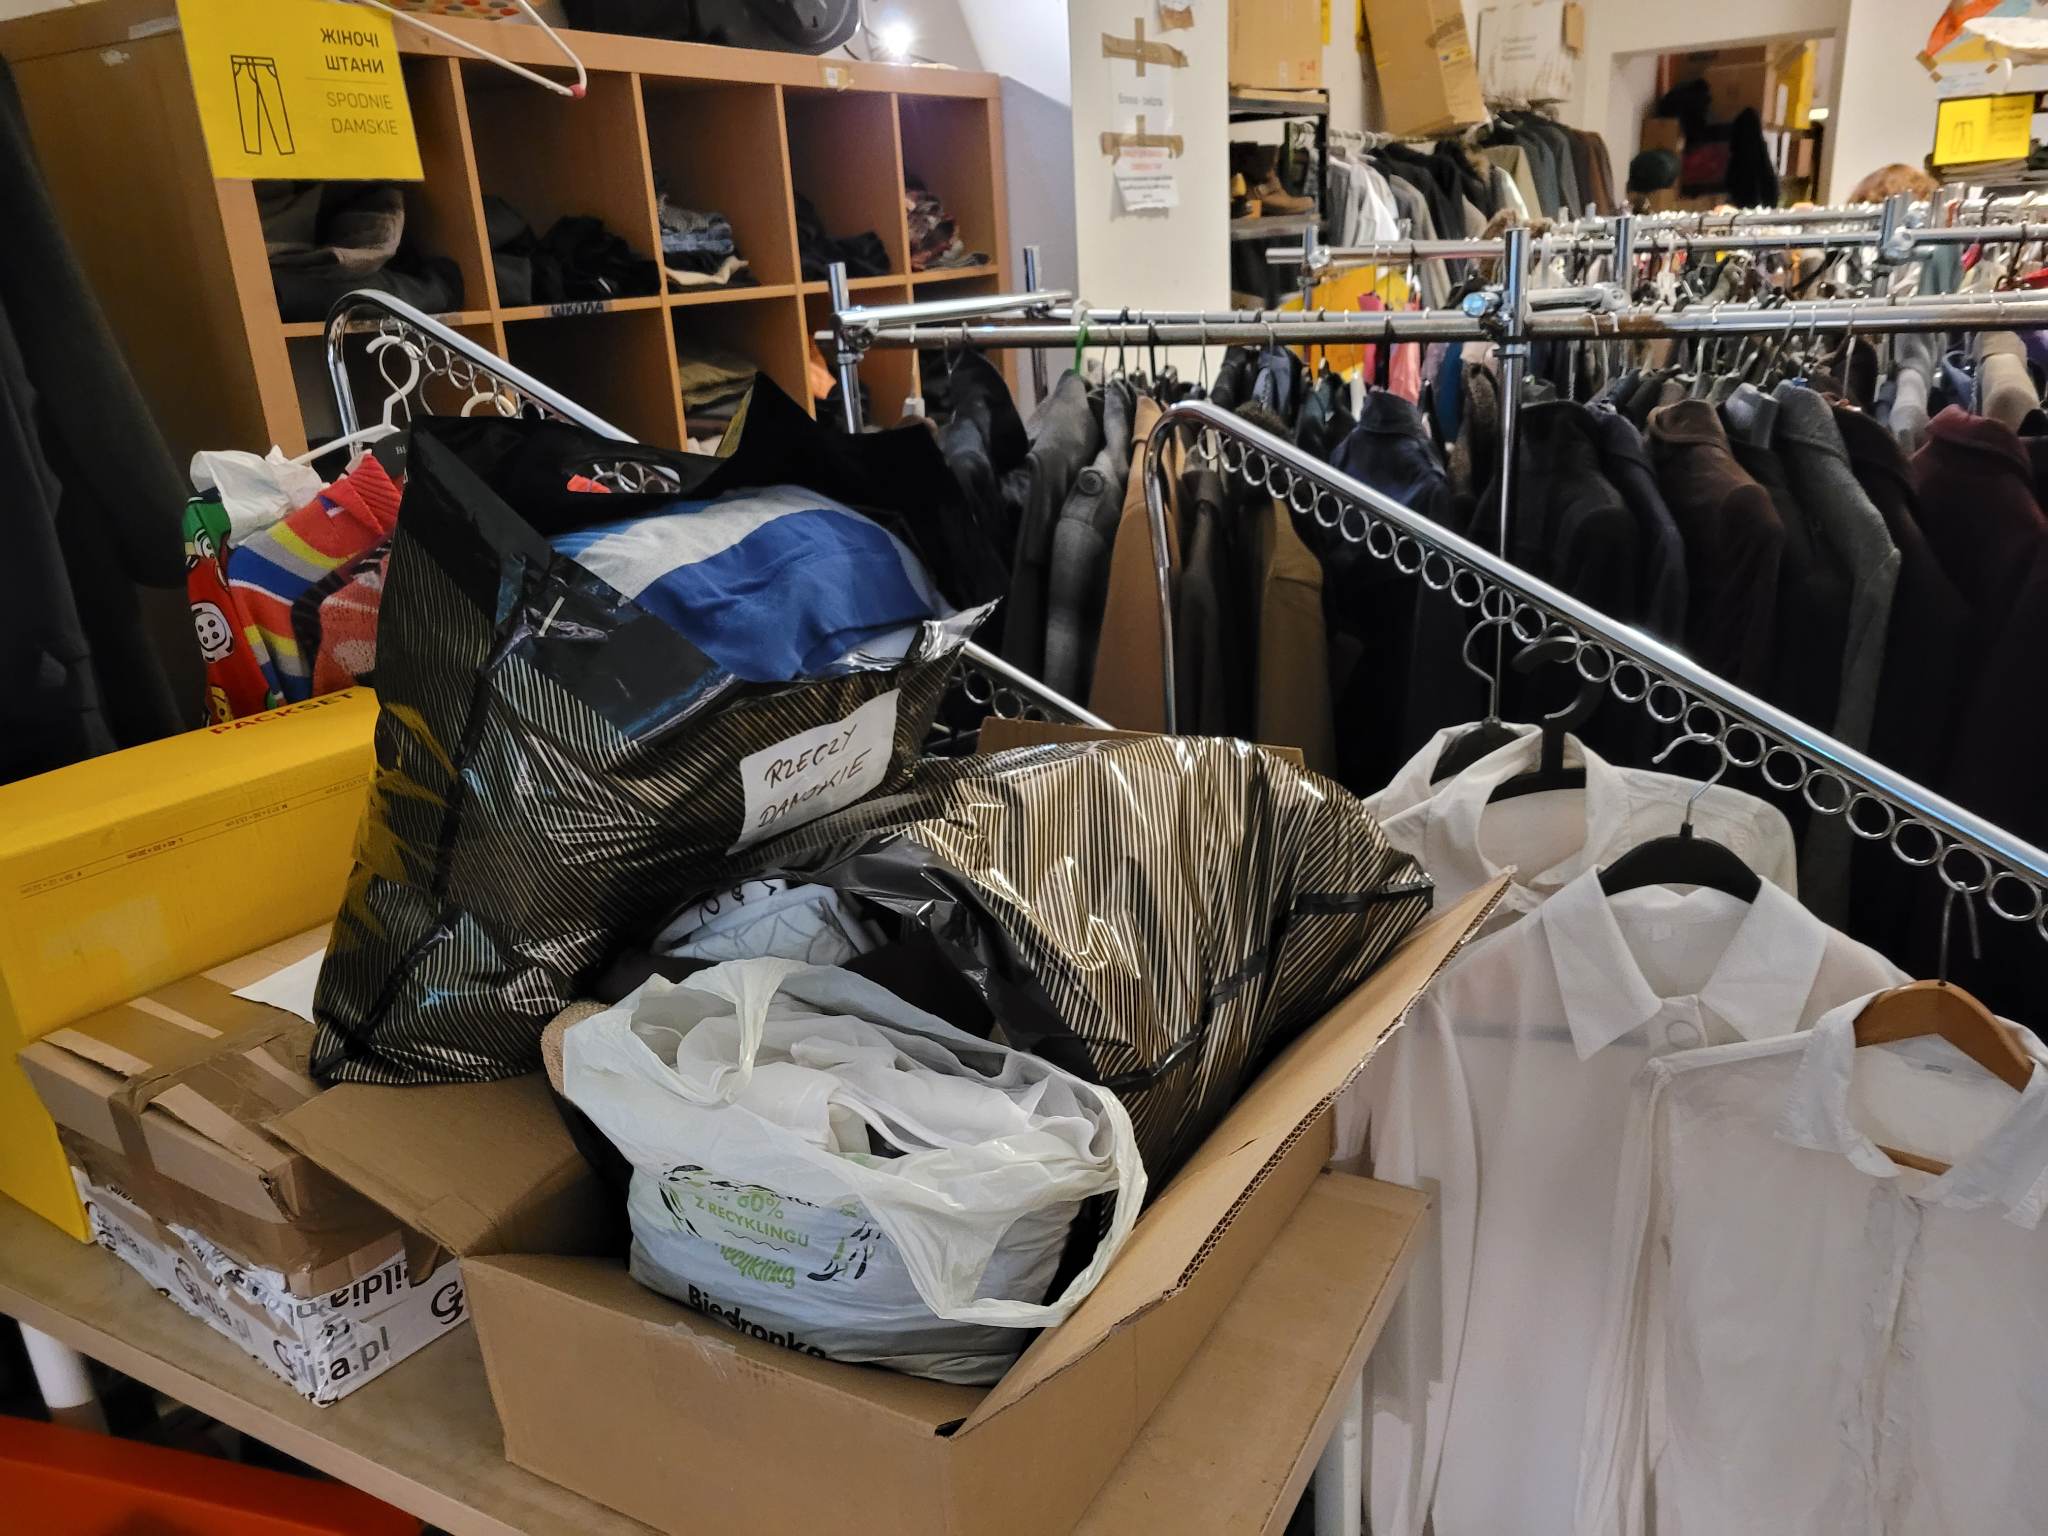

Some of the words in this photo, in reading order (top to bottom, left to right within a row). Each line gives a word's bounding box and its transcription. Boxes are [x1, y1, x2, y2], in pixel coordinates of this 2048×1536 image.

[320, 27, 379, 48] ЖІНОЧІ
[325, 55, 385, 73] ШТАНИ
[326, 91, 393, 110] SPODNIE
[331, 117, 398, 135] DAMSKIE
[210, 692, 353, 735] PACKSET
[764, 723, 857, 788] RZECZY
[708, 1203, 809, 1248] RECYKLINGU
